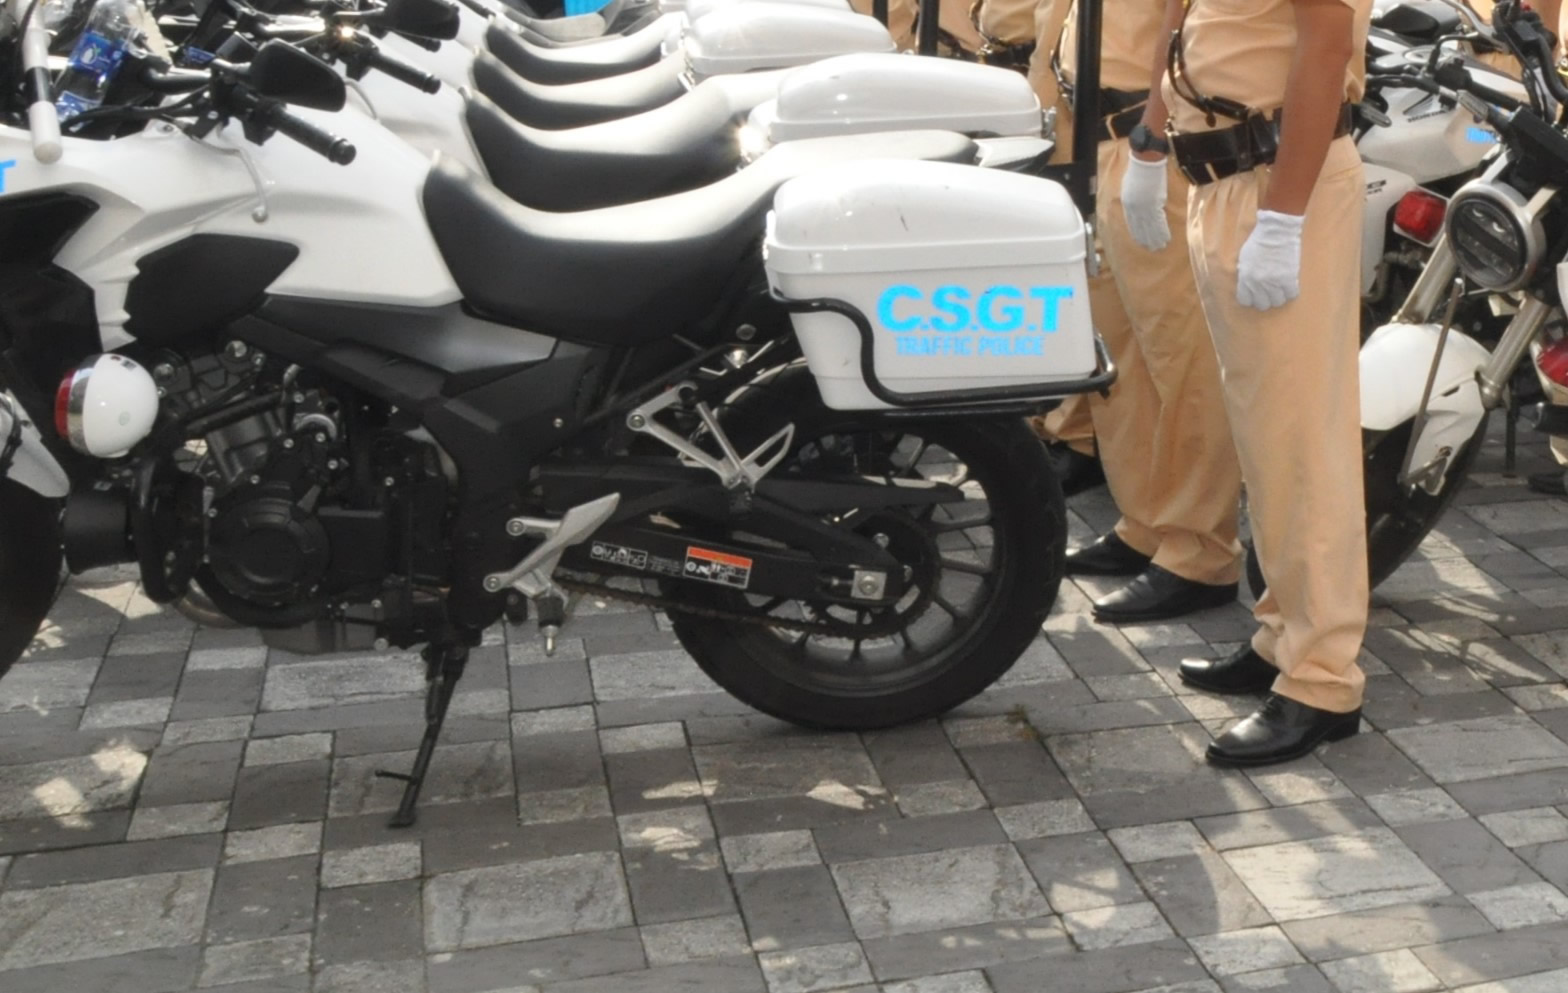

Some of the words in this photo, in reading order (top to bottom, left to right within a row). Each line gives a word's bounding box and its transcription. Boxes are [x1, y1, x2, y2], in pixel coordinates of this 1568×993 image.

[876, 283, 1074, 333] C.S.G.T
[895, 335, 973, 356] TRAFFIC
[977, 335, 1045, 357] POLICE
